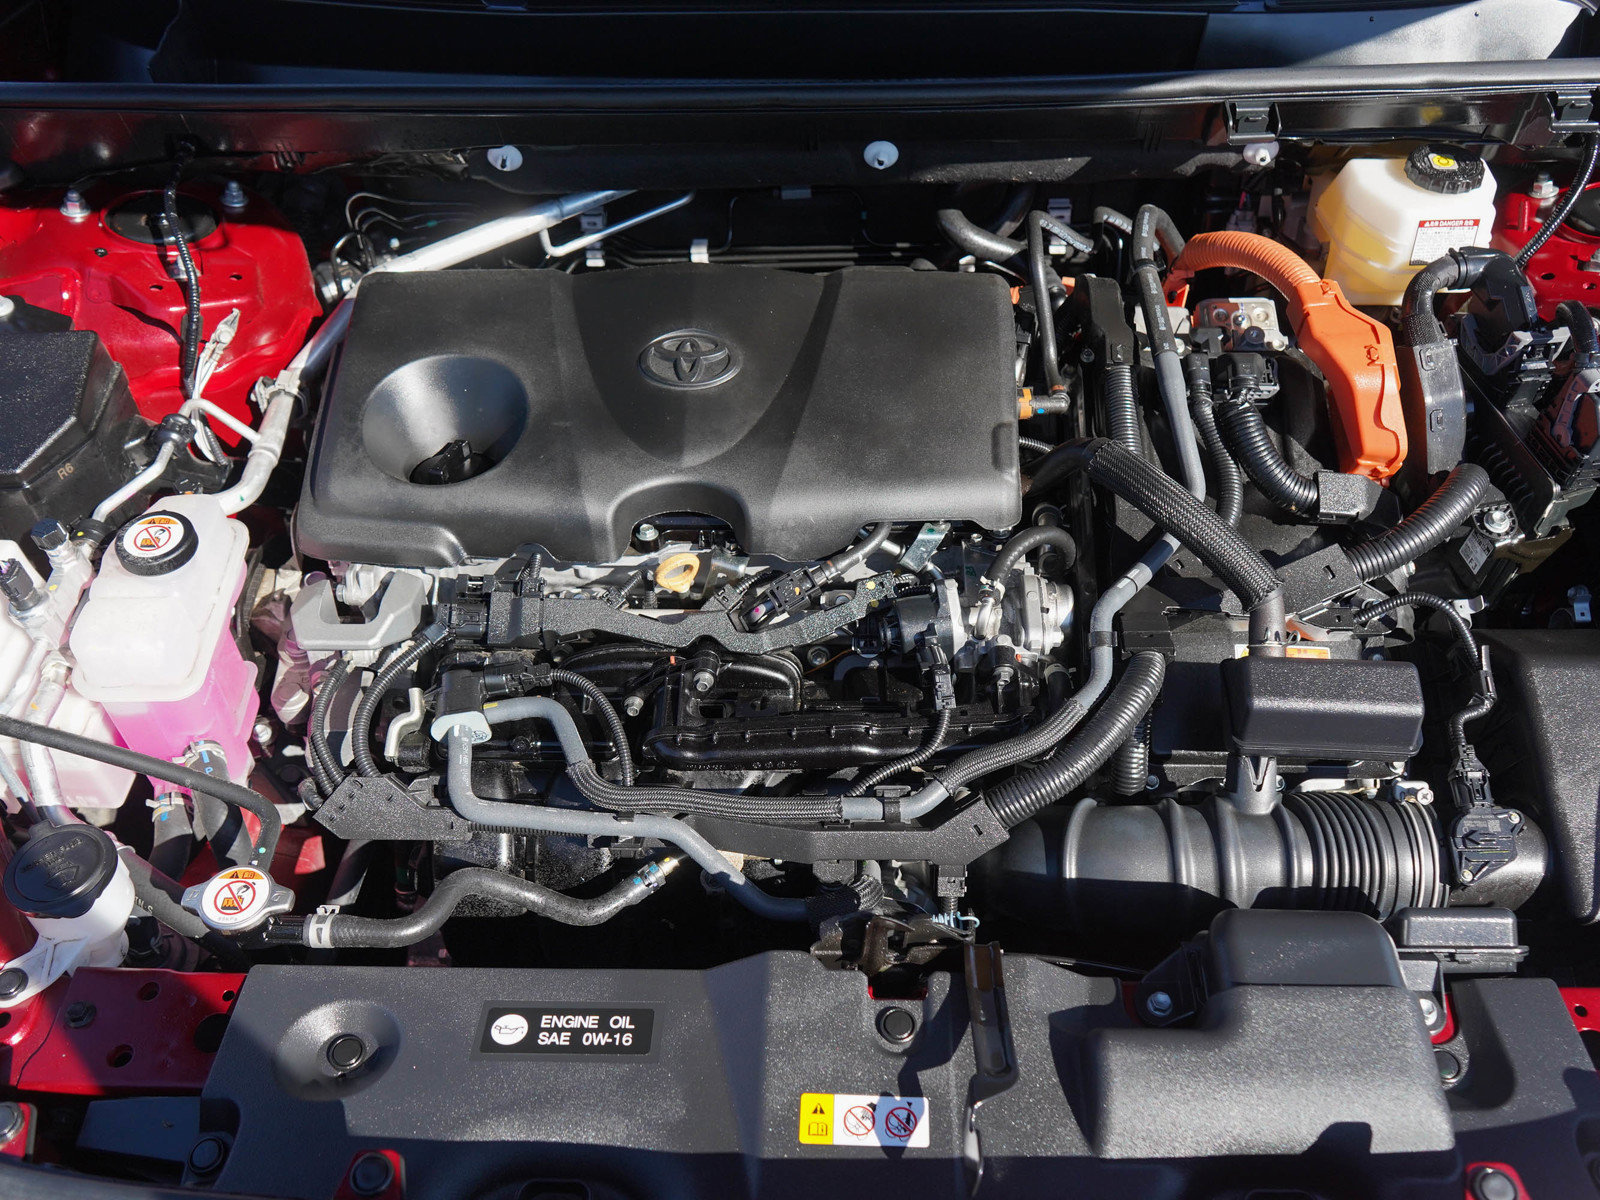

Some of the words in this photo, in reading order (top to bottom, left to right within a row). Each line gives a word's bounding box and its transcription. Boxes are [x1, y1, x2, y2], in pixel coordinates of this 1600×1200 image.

[57, 463, 74, 480] R6
[540, 1015, 599, 1029] ENGINE
[609, 1015, 635, 1029] OIL
[537, 1032, 572, 1046] SAE
[582, 1032, 633, 1046] 0W-16
